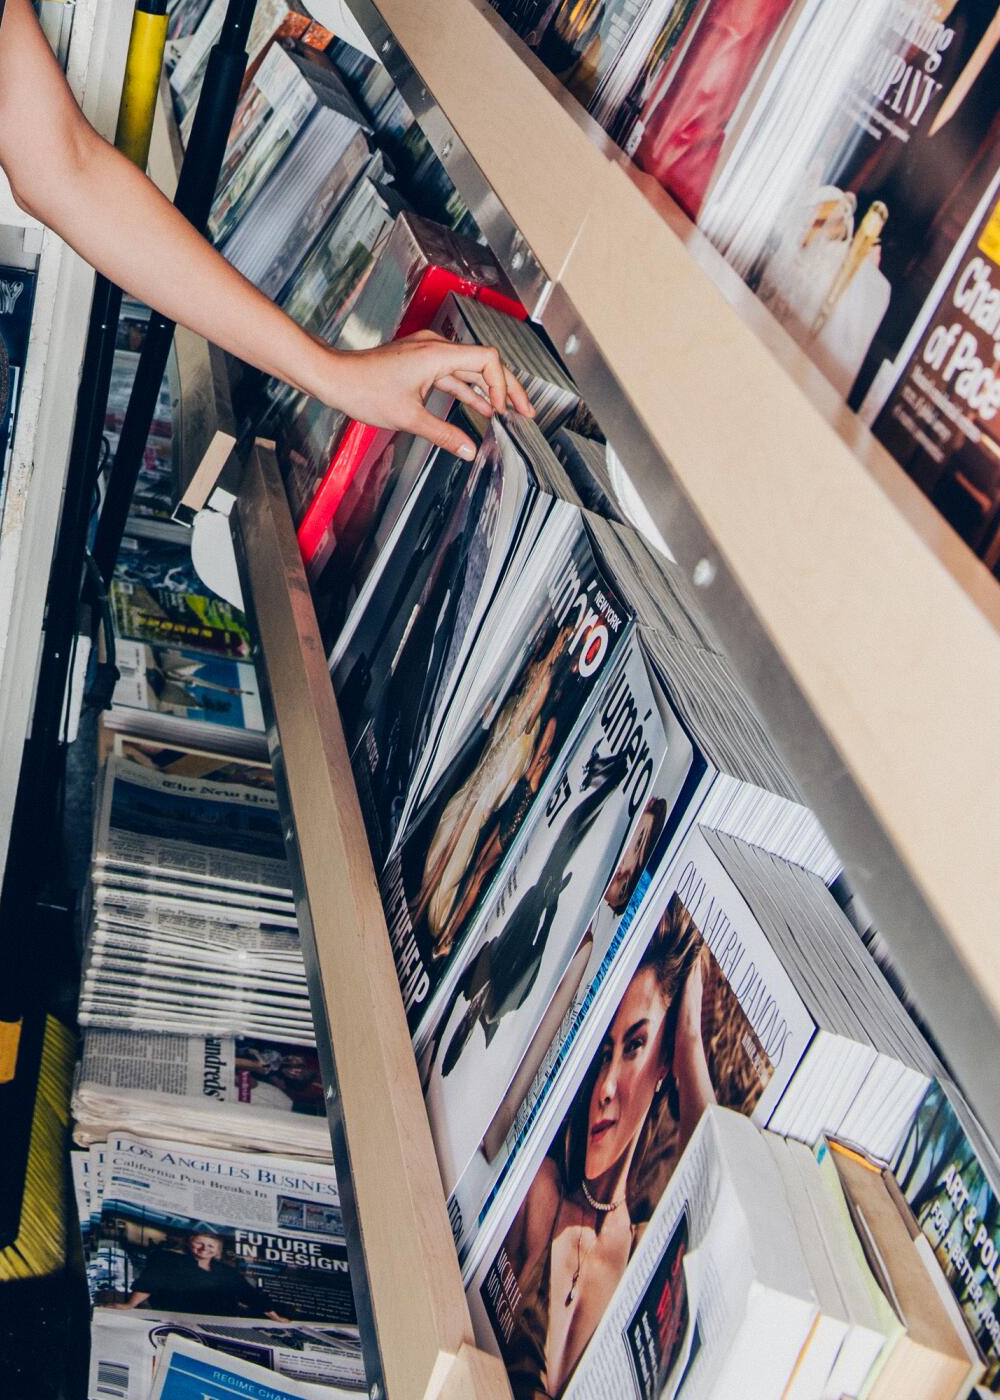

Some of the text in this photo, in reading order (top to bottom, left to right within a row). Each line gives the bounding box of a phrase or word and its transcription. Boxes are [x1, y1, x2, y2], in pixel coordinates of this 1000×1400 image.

[923, 322, 963, 372] of
[600, 666, 654, 819] uméro
[116, 1140, 154, 1159] LOS
[160, 1152, 250, 1180] ANGELES
[942, 1162, 969, 1212] ART
[963, 1206, 977, 1236] &
[235, 1230, 322, 1257] FUTURE
[235, 1243, 349, 1273] IN DESIGN
[930, 1201, 950, 1240] FOR
[950, 1246, 983, 1304] BETTER
[212, 1370, 257, 1393] REGIME
